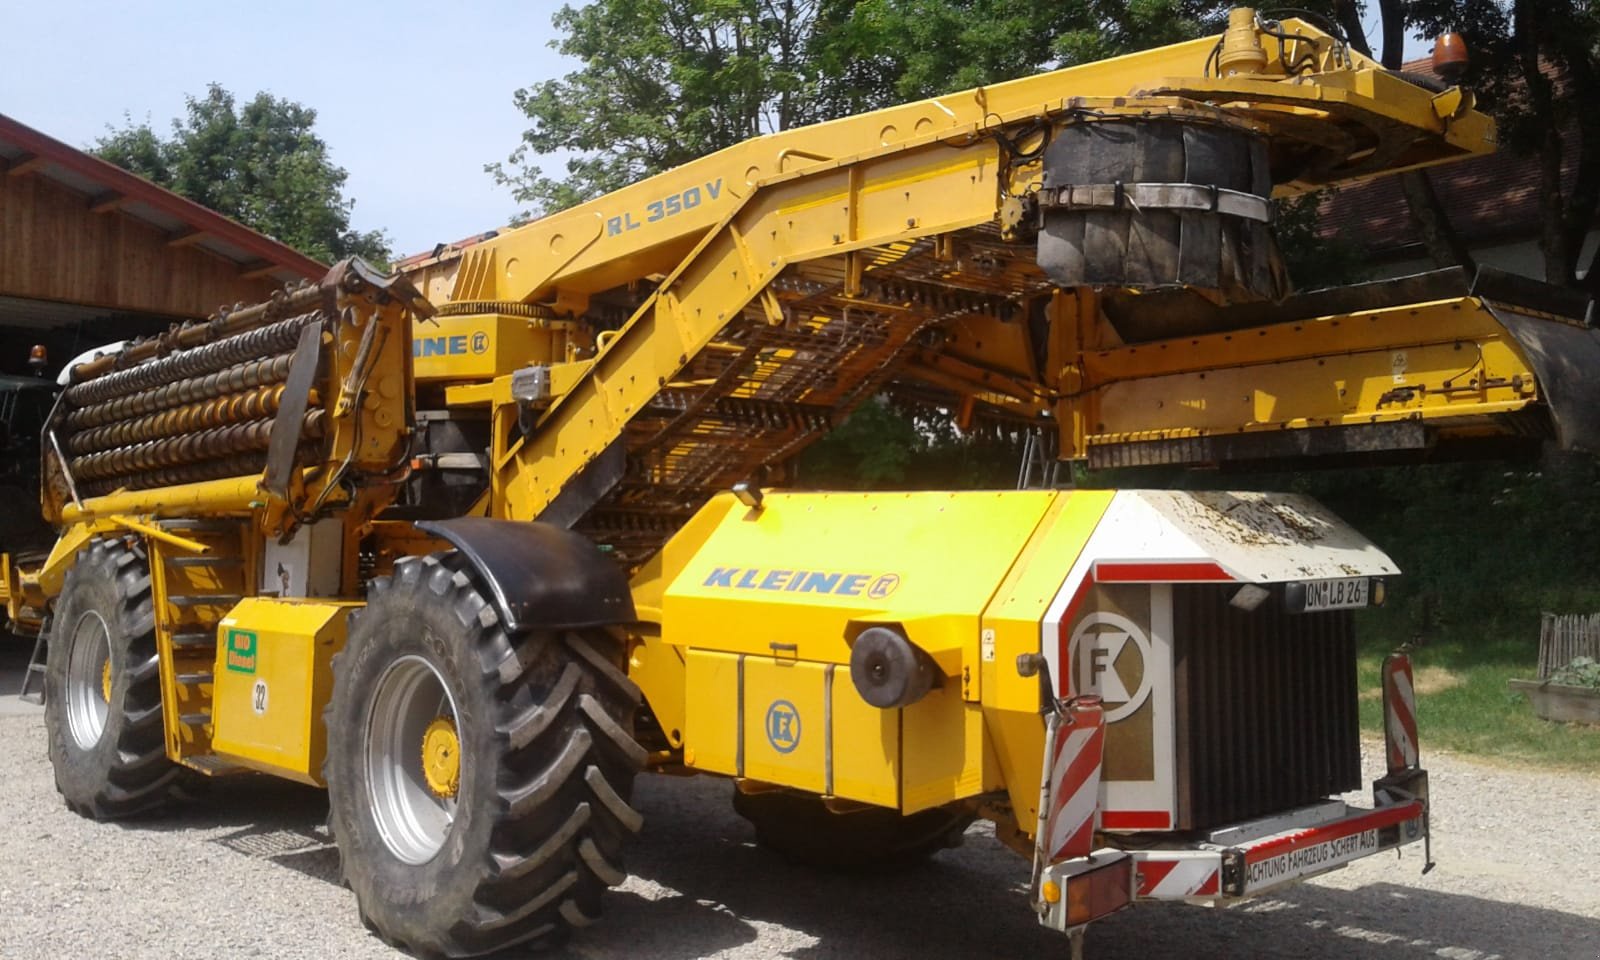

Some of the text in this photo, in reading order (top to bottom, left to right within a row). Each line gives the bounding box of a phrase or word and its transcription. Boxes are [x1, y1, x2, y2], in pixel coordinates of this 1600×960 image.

[607, 178, 723, 237] RL 350 V
[413, 335, 467, 357] INE
[703, 567, 872, 596] KLEINE
[1329, 581, 1344, 605] LB
[1347, 580, 1361, 603] 26
[255, 684, 266, 710] 32
[1246, 830, 1376, 882] ACHTUNG FAHRZEUG SCHERT AUS
